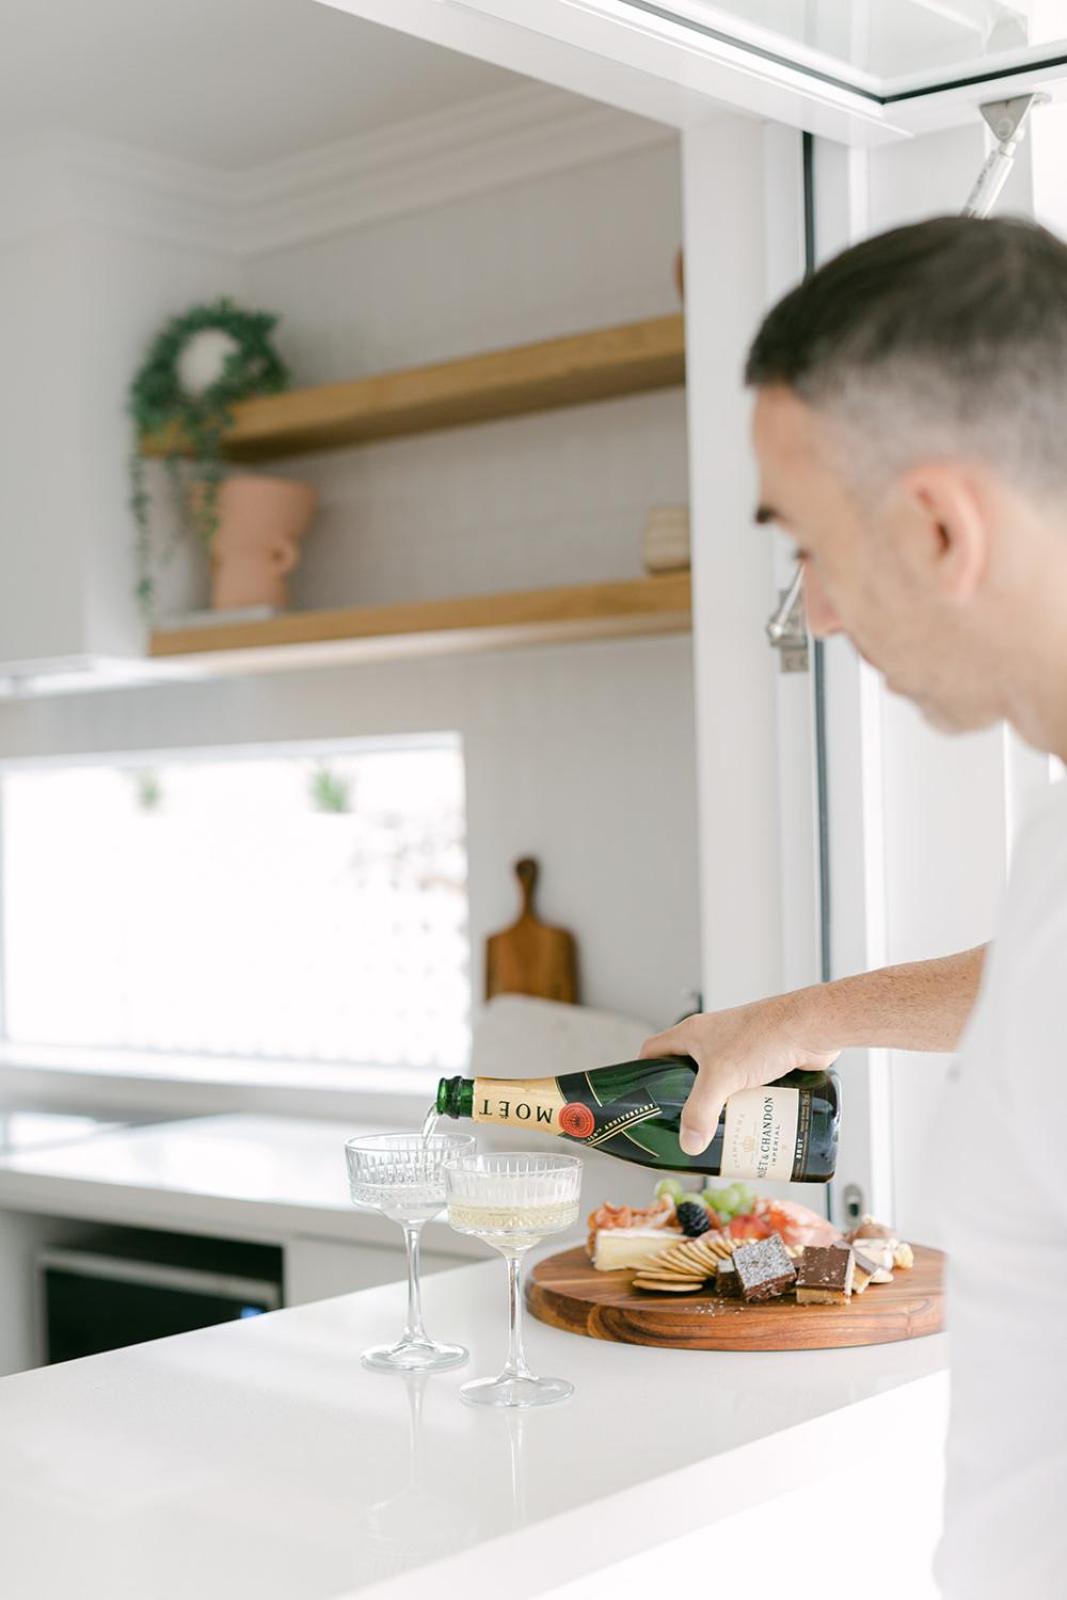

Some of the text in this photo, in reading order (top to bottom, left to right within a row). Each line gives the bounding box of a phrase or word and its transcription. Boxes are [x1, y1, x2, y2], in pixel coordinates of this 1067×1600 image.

[479, 1099, 553, 1124] MOËT
[761, 1096, 773, 1152] CHANDON
[796, 1138, 804, 1159] BRUT
